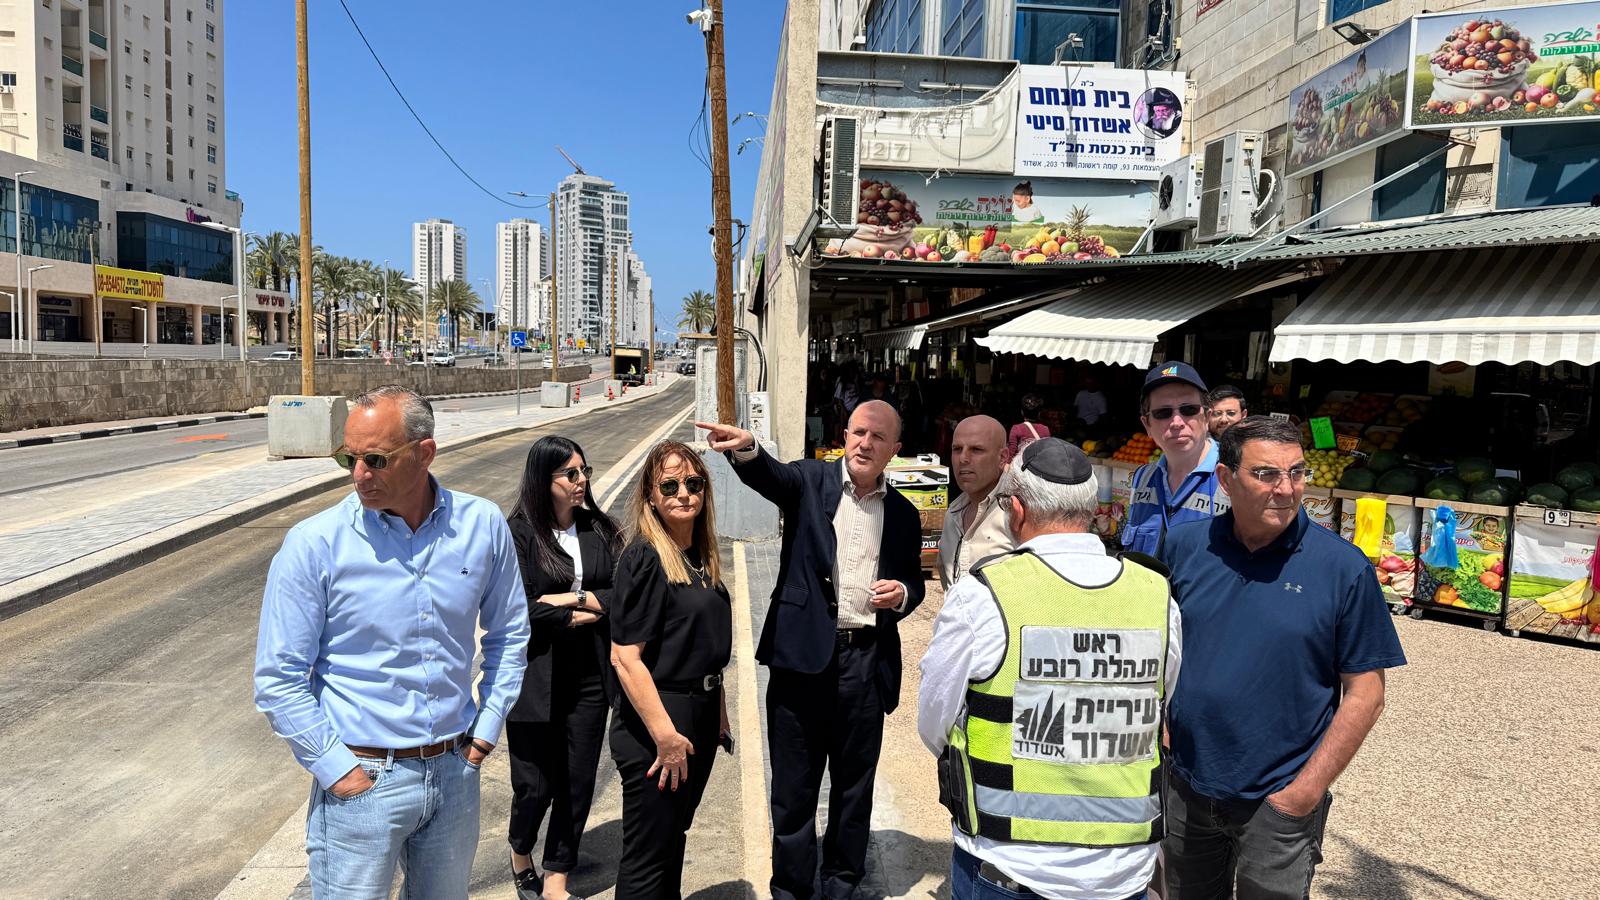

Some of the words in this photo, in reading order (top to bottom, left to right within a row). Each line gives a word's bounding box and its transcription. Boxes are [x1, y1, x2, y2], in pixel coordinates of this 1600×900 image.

[1028, 86, 1086, 107] מנחם
[1094, 89, 1131, 109] בית
[1026, 114, 1065, 131] סיטי
[1070, 116, 1131, 134] אשדוד
[1089, 143, 1126, 155] כנסת
[1130, 145, 1155, 156] בית
[1103, 163, 1118, 171] קומה
[1548, 511, 1555, 524] 9
[1073, 633, 1121, 653] ראש
[1027, 658, 1081, 678] רובע
[1091, 655, 1160, 678] מנהלת
[1072, 697, 1157, 725] עיריית
[1014, 740, 1066, 758] אשדוד
[1072, 731, 1154, 758] אשדוד
